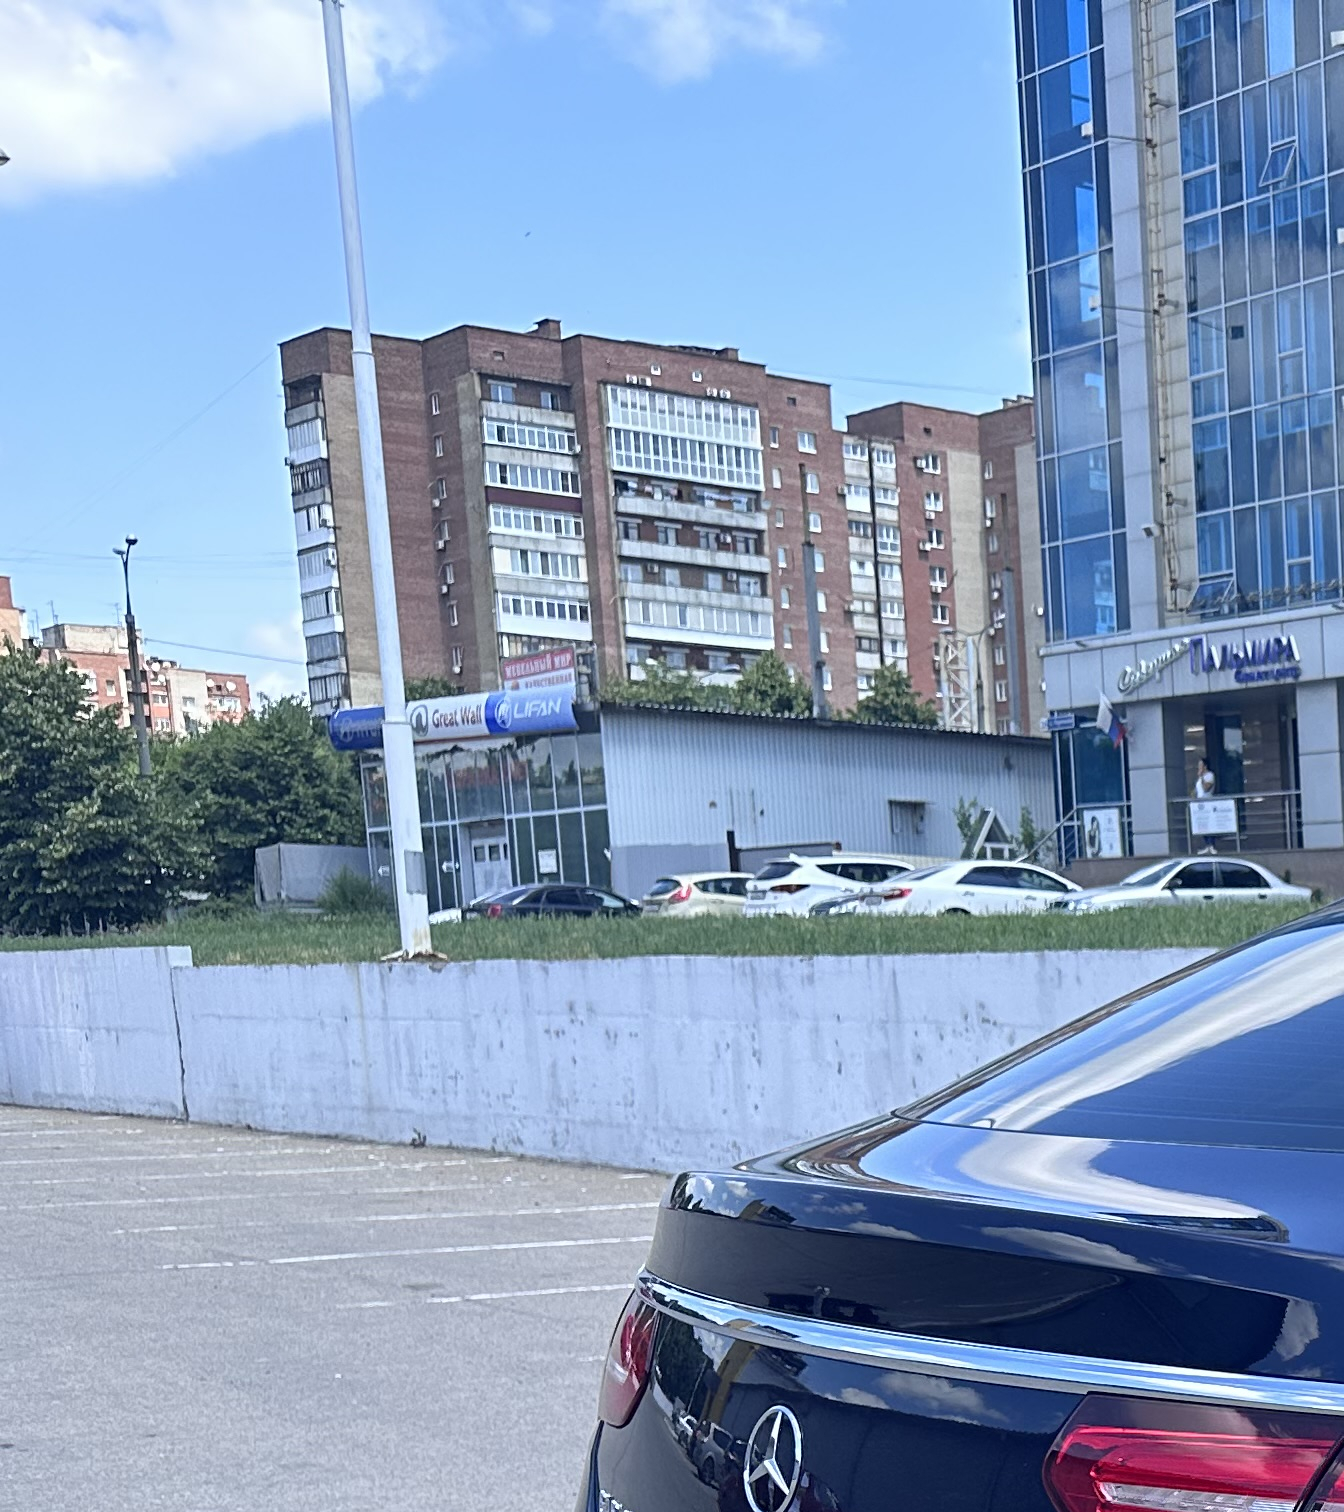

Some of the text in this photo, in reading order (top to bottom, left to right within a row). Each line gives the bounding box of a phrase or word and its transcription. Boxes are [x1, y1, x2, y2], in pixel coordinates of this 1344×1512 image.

[432, 704, 482, 729] Great Wall
[515, 697, 562, 719] LIFAN
